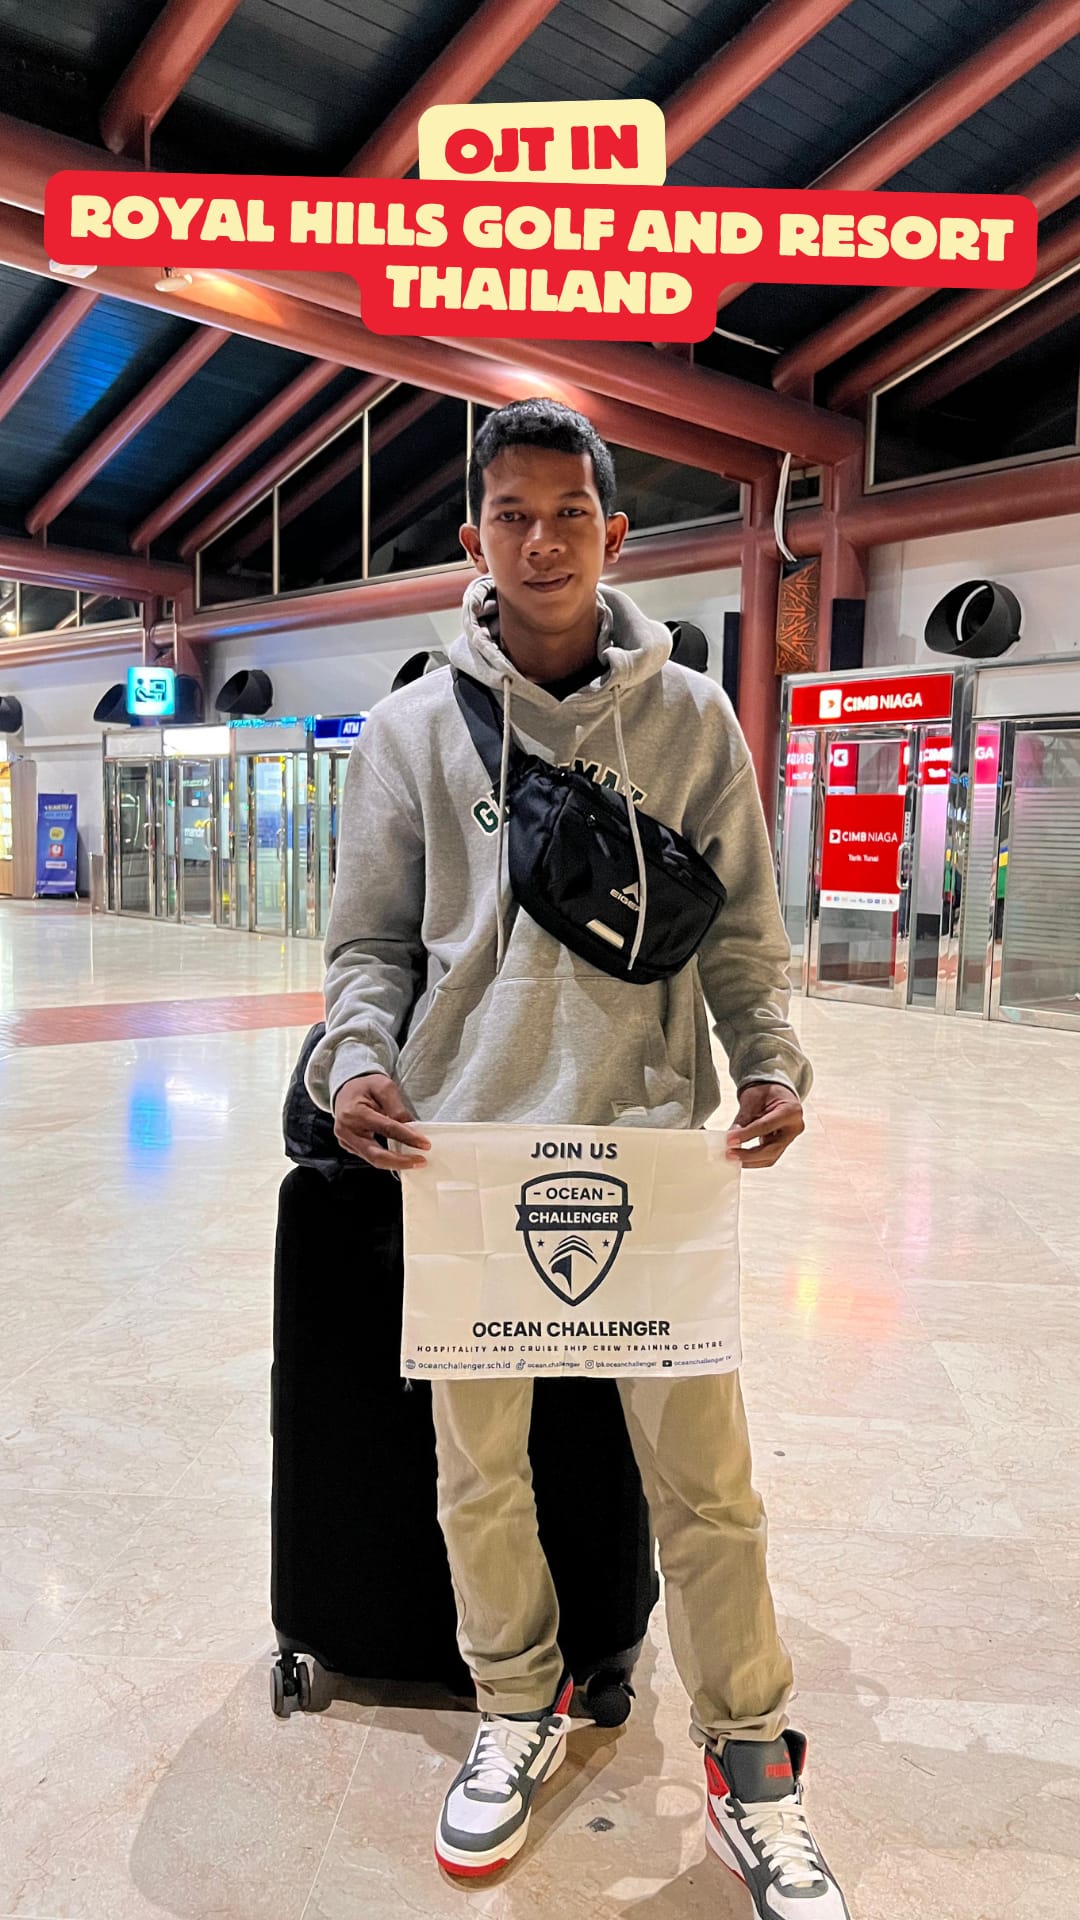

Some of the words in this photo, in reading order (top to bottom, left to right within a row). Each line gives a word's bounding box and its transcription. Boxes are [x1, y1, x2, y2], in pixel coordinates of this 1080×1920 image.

[843, 695, 878, 712] CIMB
[880, 692, 922, 709] NIAGA
[342, 721, 360, 735] ATM
[842, 831, 867, 842] CIMB
[868, 832, 898, 843] NIAGA
[531, 1142, 582, 1159] JOIN
[590, 1142, 618, 1160] US
[546, 1187, 603, 1201] OCEAN
[528, 1211, 619, 1225] CHALLENGER
[473, 1321, 542, 1338] OCEAN
[547, 1321, 670, 1338] CHALLENGER
[417, 1345, 487, 1353] HOSPITALITY
[627, 1344, 678, 1352] TRAINING
[684, 1340, 723, 1351] CENTRE
[418, 1360, 511, 1371] oceanchallenger.sch.id
